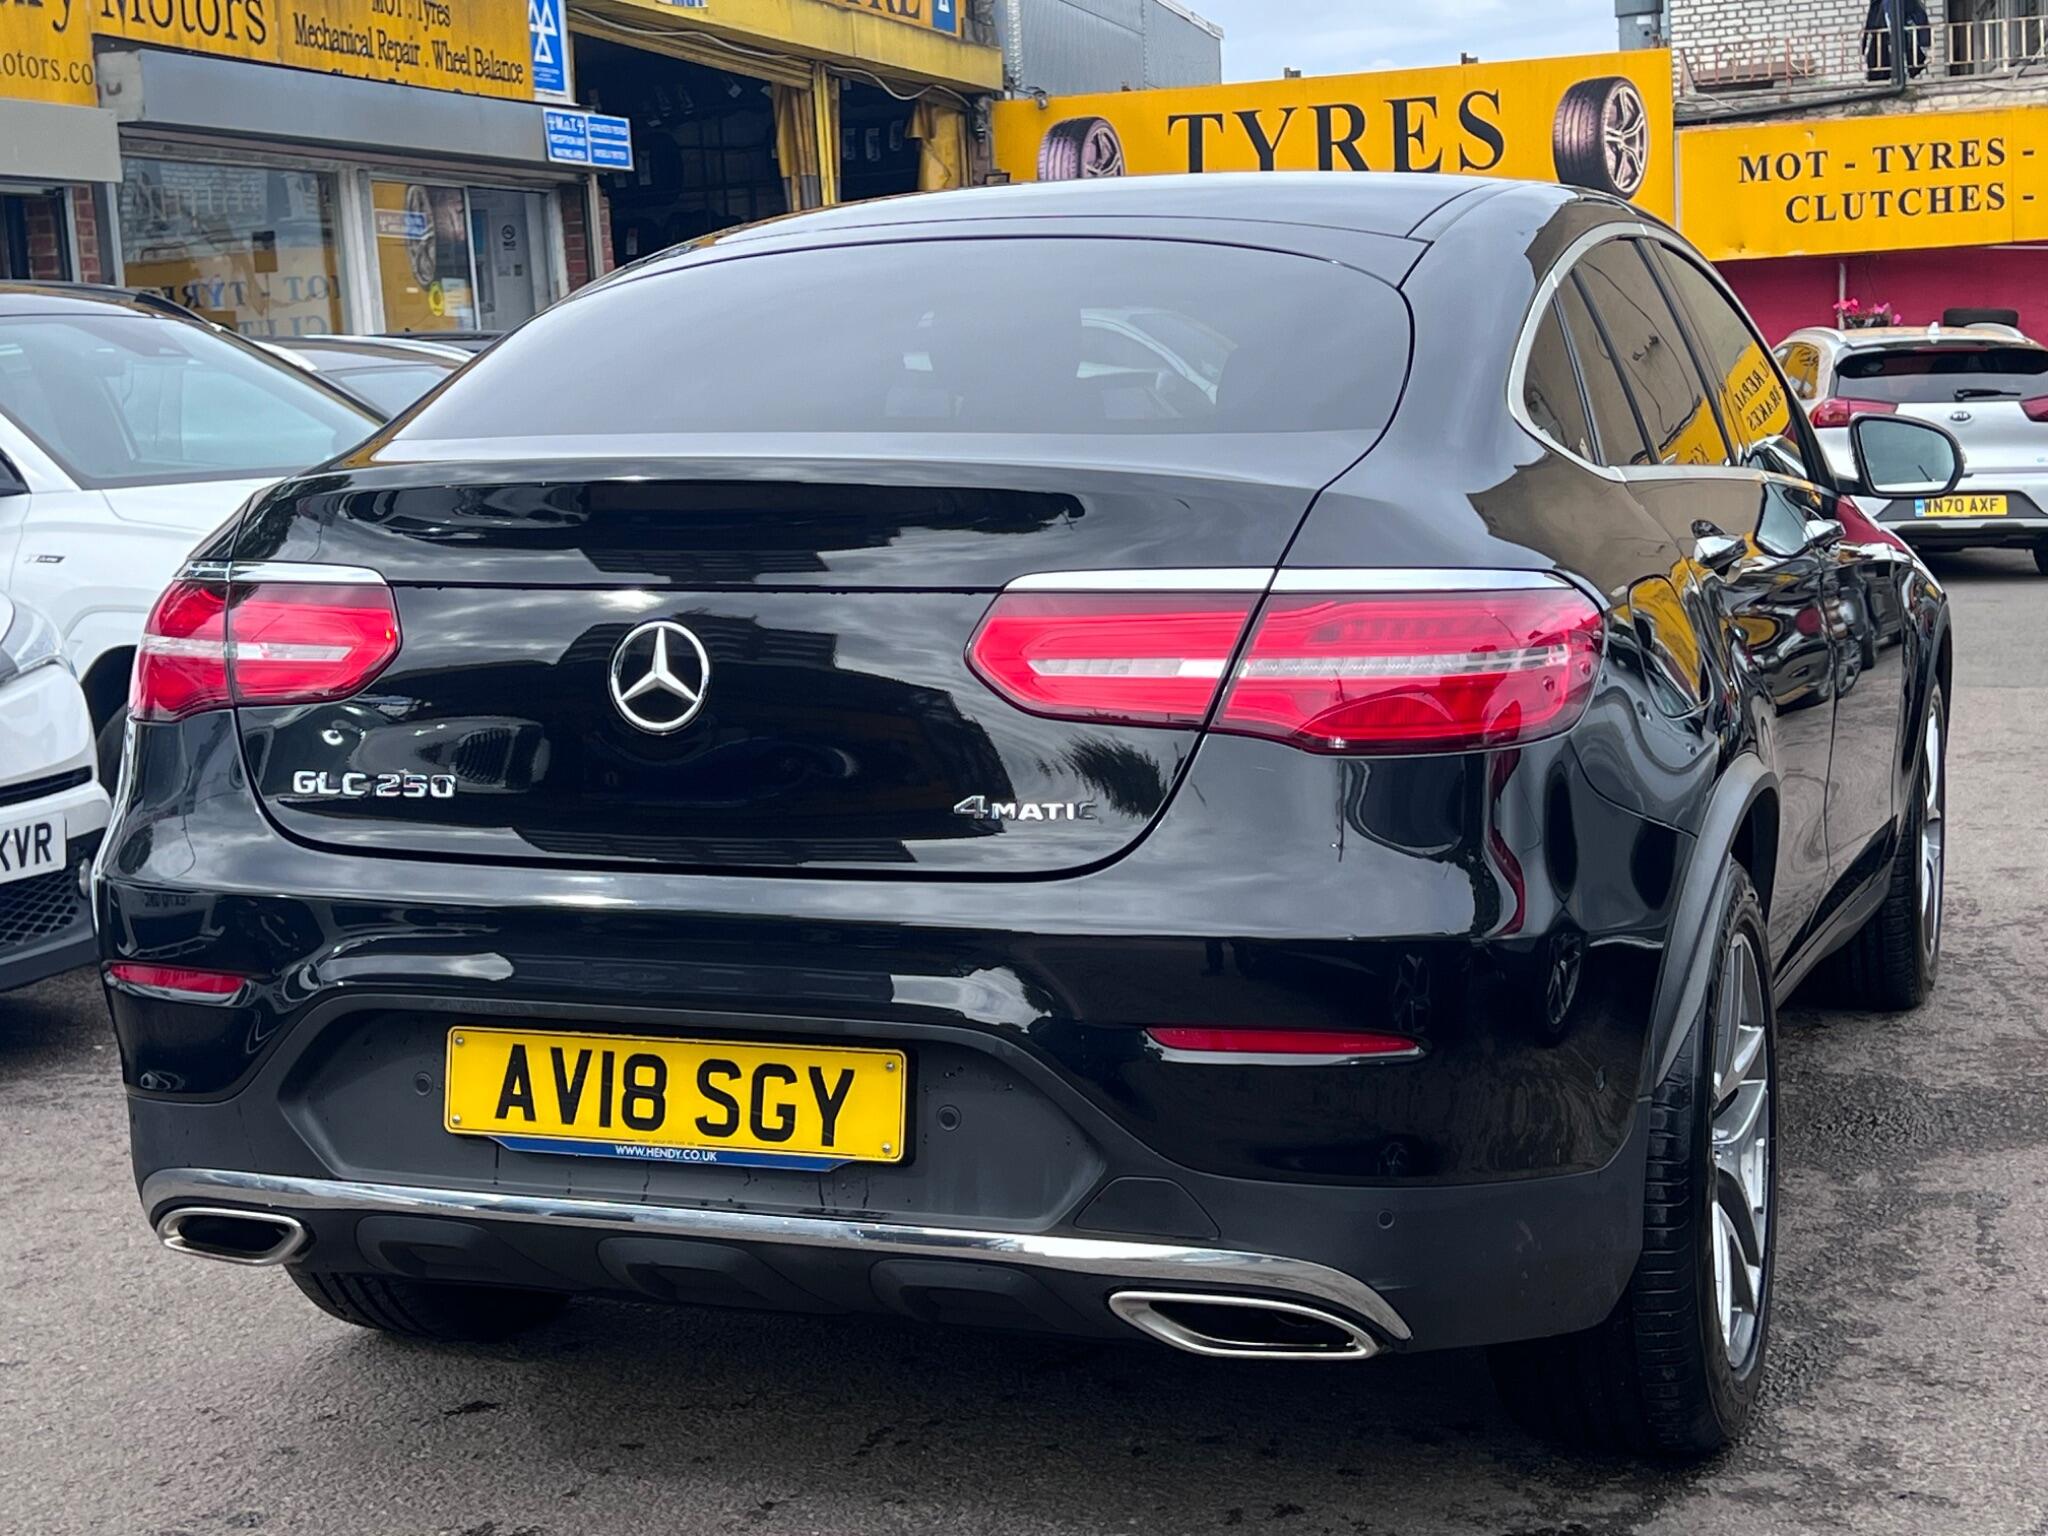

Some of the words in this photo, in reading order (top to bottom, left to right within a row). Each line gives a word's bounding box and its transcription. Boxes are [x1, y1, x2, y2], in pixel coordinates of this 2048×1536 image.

[417, 0, 450, 31] Tyres
[293, 12, 374, 58] Mechanical
[376, 29, 421, 72] Repair
[431, 40, 471, 76] Wheel
[474, 47, 524, 84] Balance
[0, 49, 94, 86] otors.co
[1168, 88, 1505, 173] TYRES
[1738, 150, 1829, 183] MOT
[1872, 137, 2005, 174] TYRES
[1785, 182, 2005, 224] CLUTCHES
[1969, 498, 1999, 513] AXF
[293, 770, 367, 796] GLC
[375, 773, 457, 799] 250
[953, 795, 1098, 821] 4MATIC
[494, 1043, 668, 1131] AV18
[695, 1058, 855, 1147] SGY
[615, 1145, 718, 1162] WWW.HENDY.CO.UK
